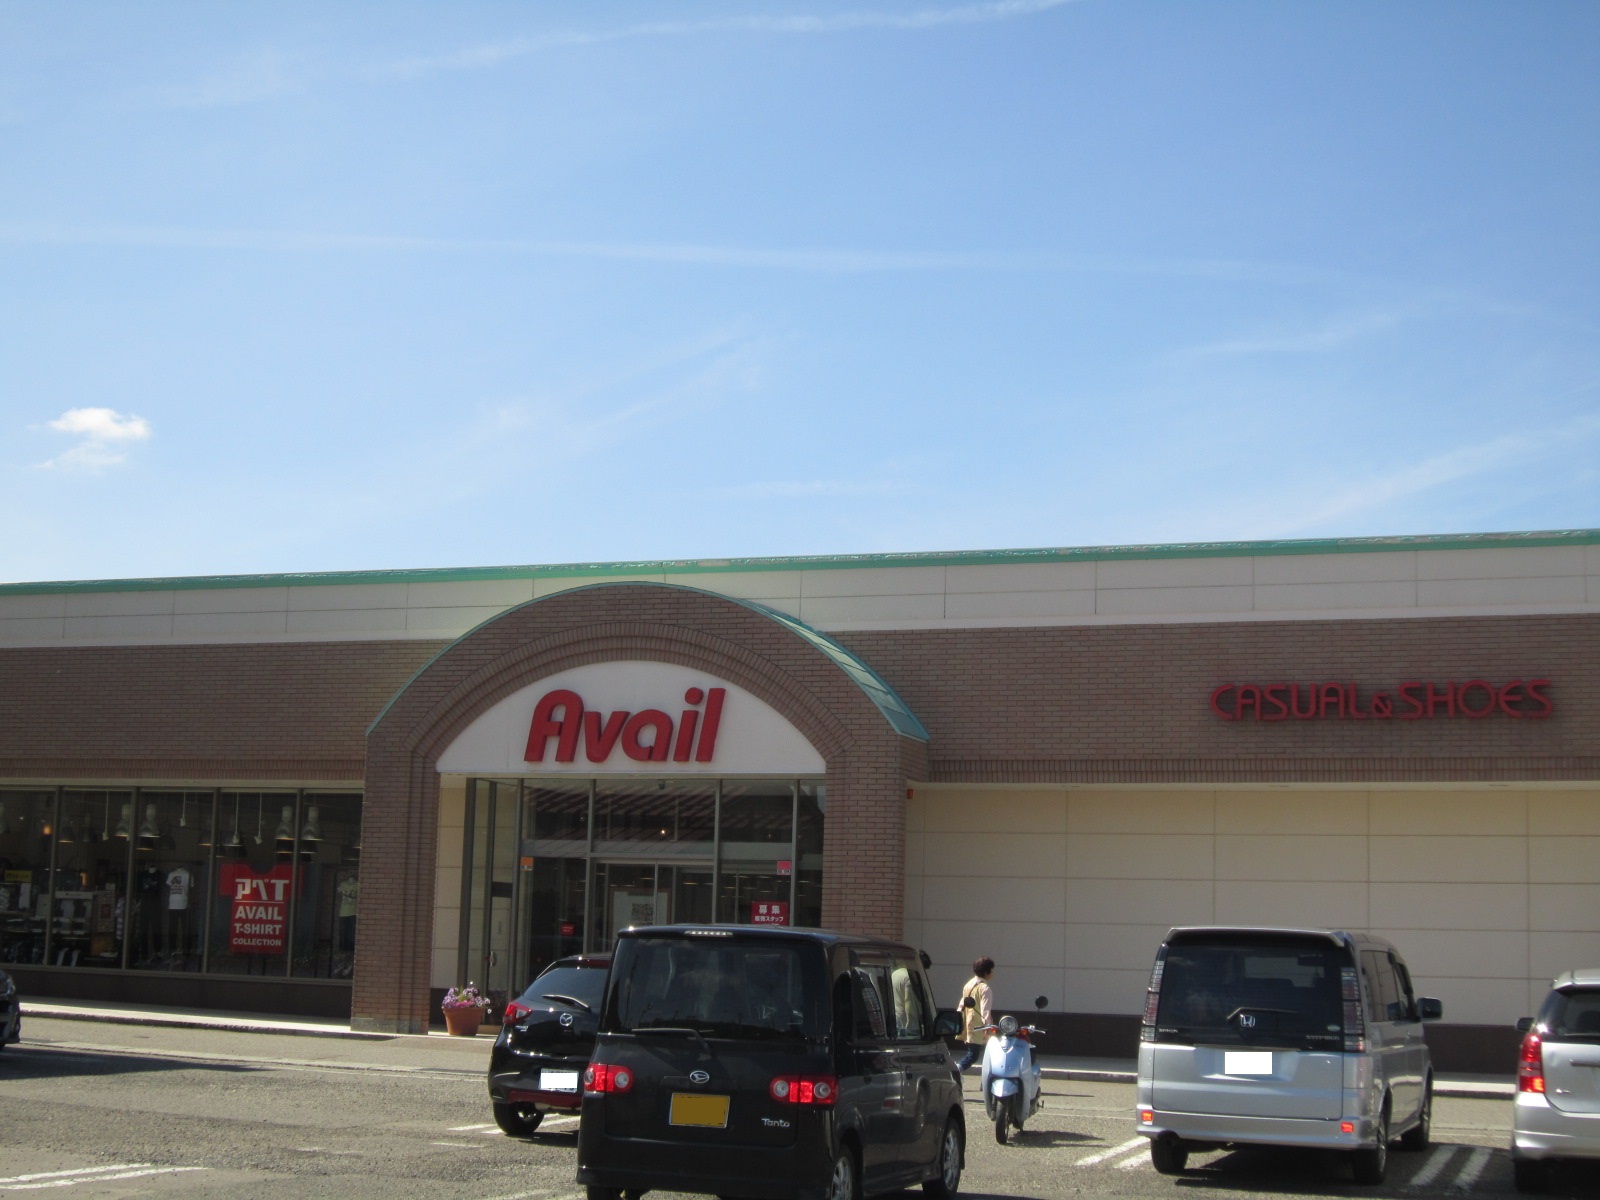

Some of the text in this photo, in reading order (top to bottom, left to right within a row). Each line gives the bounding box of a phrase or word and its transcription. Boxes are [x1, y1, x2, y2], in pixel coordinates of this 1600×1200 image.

[1209, 679, 1553, 721] CASUAL & SHOES
[523, 686, 727, 763] Avail
[234, 905, 283, 921] AVAIL
[233, 922, 282, 935] T-SHIRT
[232, 937, 282, 946] COLLECTION
[761, 1117, 791, 1127] Tanto
